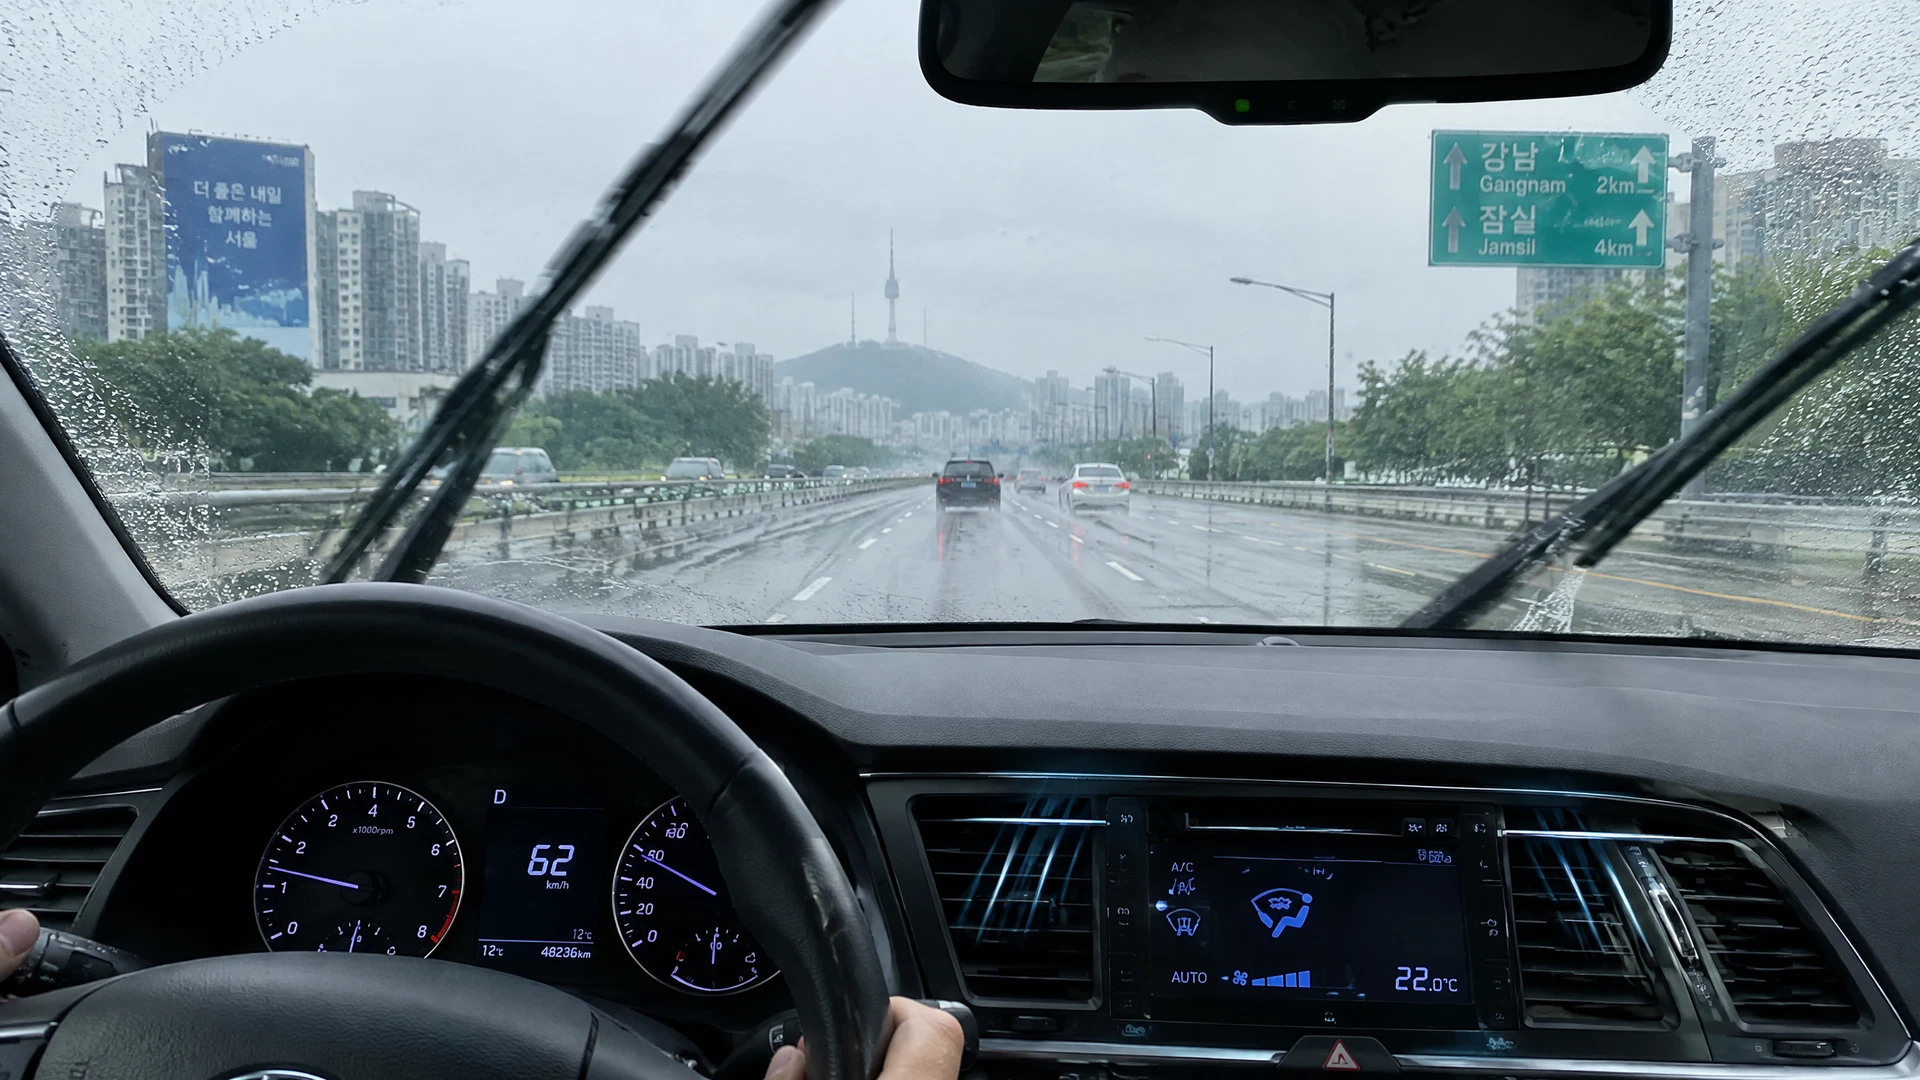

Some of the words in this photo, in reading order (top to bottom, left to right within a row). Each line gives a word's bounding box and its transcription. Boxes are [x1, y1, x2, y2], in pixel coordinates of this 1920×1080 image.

[1481, 141, 1539, 173] 강남
[193, 180, 210, 200] 더
[250, 185, 282, 205] 내일
[1479, 177, 1566, 197] Gangnam
[1596, 175, 1635, 195] 2km
[1479, 205, 1537, 235] 잠실
[225, 229, 257, 249] 서울
[1478, 238, 1536, 256] Jamsil
[1594, 239, 1634, 257] 4km
[494, 789, 507, 805] D
[368, 804, 378, 818] 4
[327, 814, 339, 828] 2
[406, 816, 416, 829] 5
[295, 841, 307, 855] 2
[430, 843, 441, 856] 6
[527, 844, 575, 877] 62
[1171, 861, 1194, 873] A/C
[281, 881, 287, 894] 1
[545, 880, 570, 890] km/h
[636, 877, 654, 890] 40
[438, 884, 447, 898] 7
[636, 902, 654, 916] 20
[287, 921, 299, 935] 0
[417, 925, 428, 939] 8
[647, 929, 658, 943] 0
[541, 946, 591, 959] 48236km
[1171, 971, 1208, 984] AUTO
